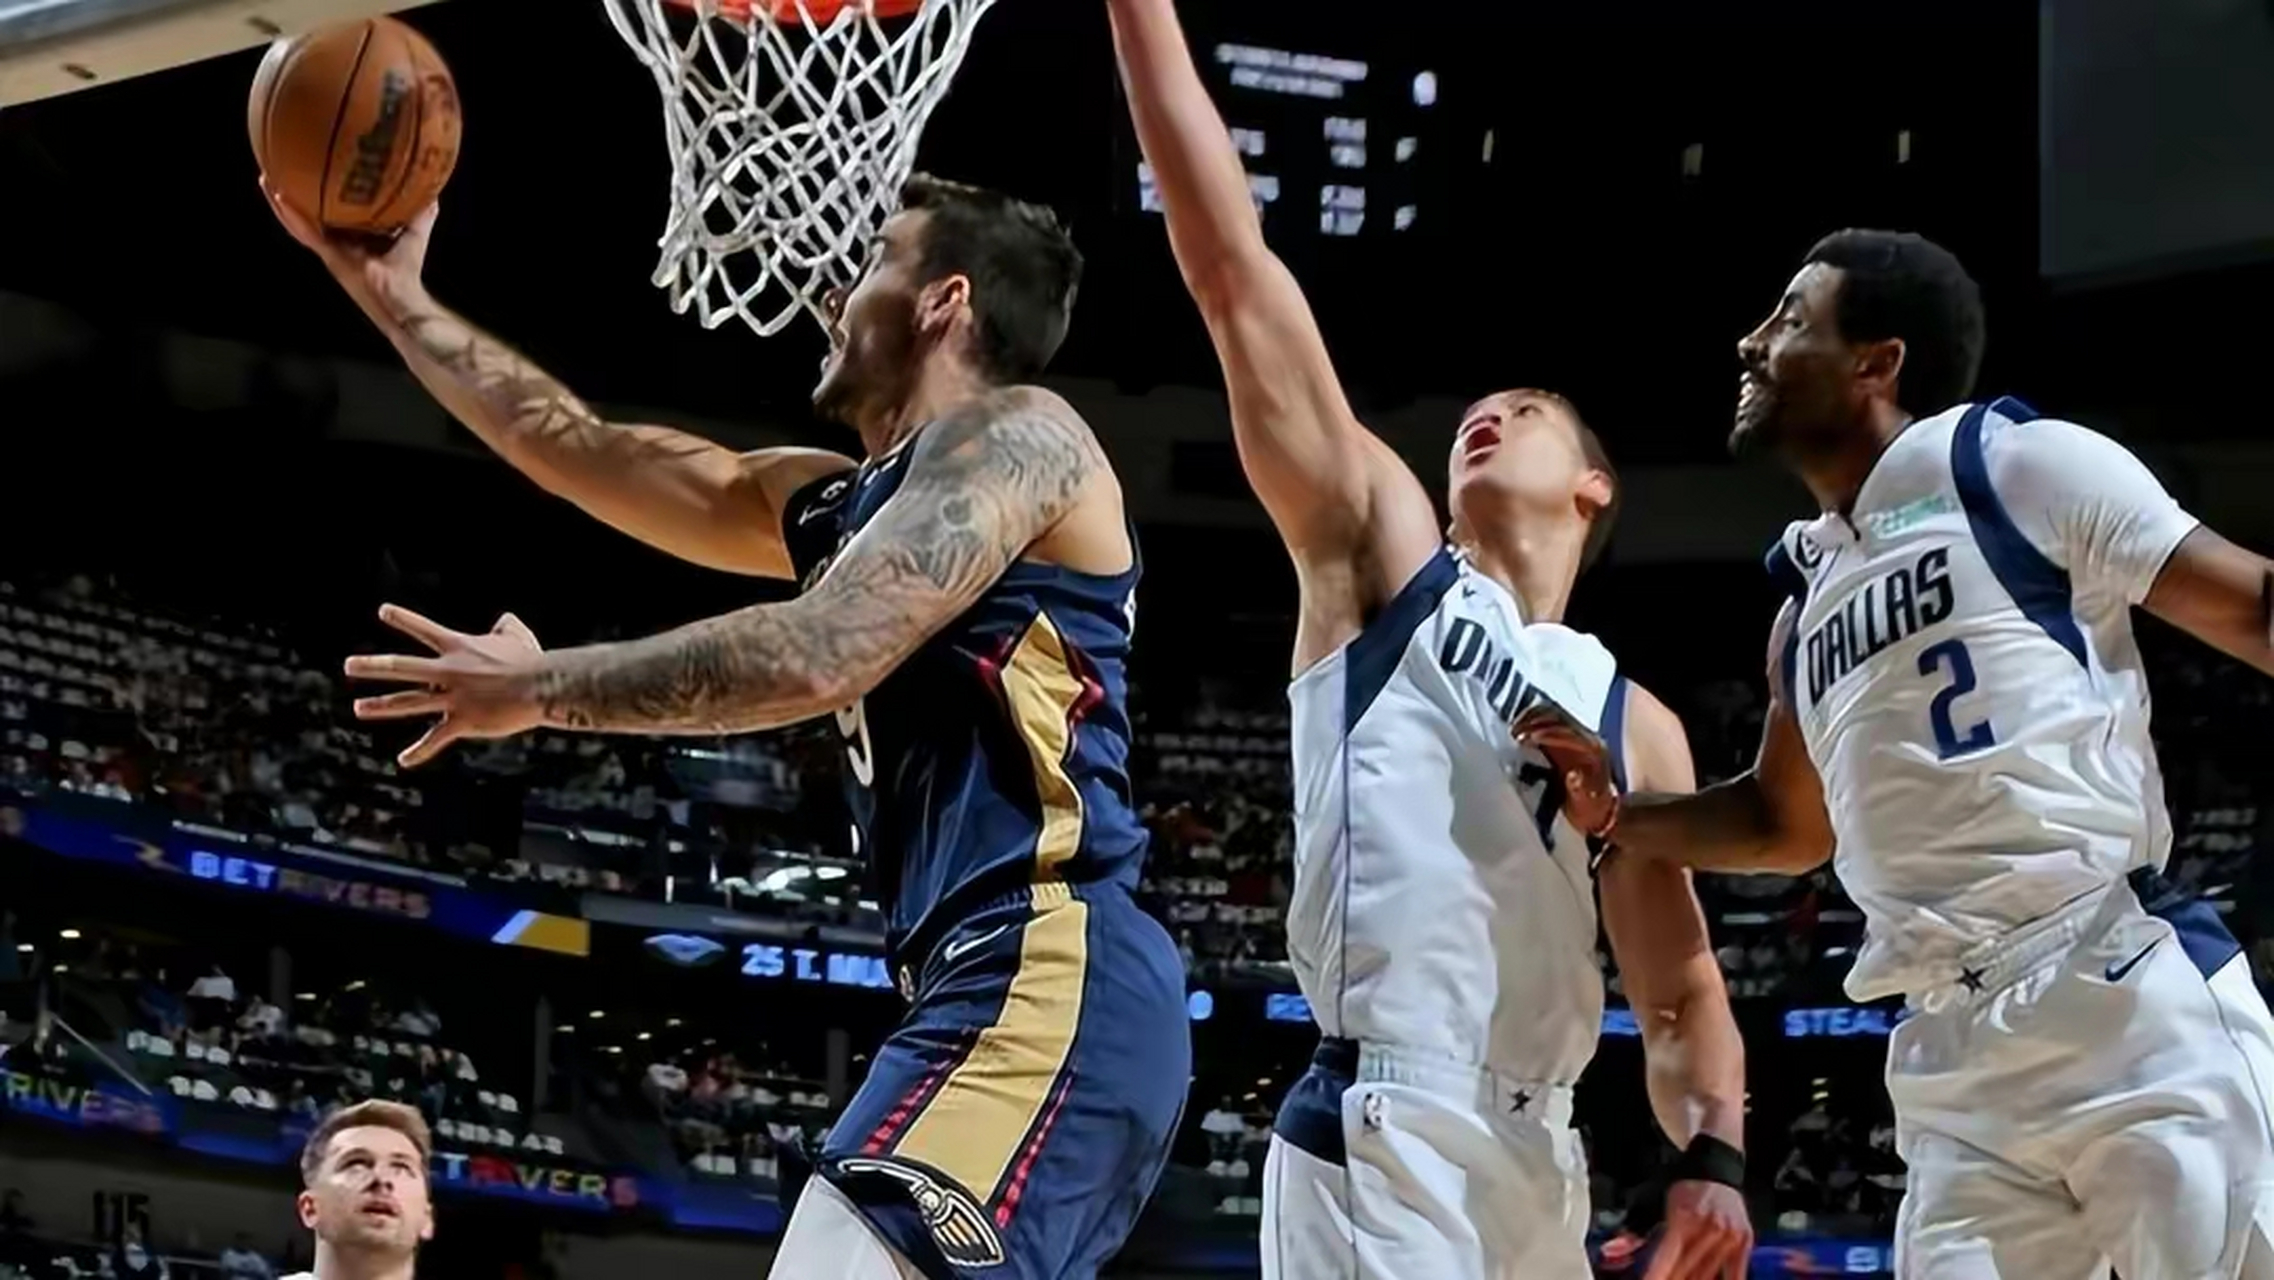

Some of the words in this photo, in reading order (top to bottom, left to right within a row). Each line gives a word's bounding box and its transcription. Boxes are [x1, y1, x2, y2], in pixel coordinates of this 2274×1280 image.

[1807, 546, 1954, 705] DALLAS
[1917, 638, 1996, 760] 2
[741, 943, 786, 977] 25
[1784, 1008, 1905, 1037] STEAL
